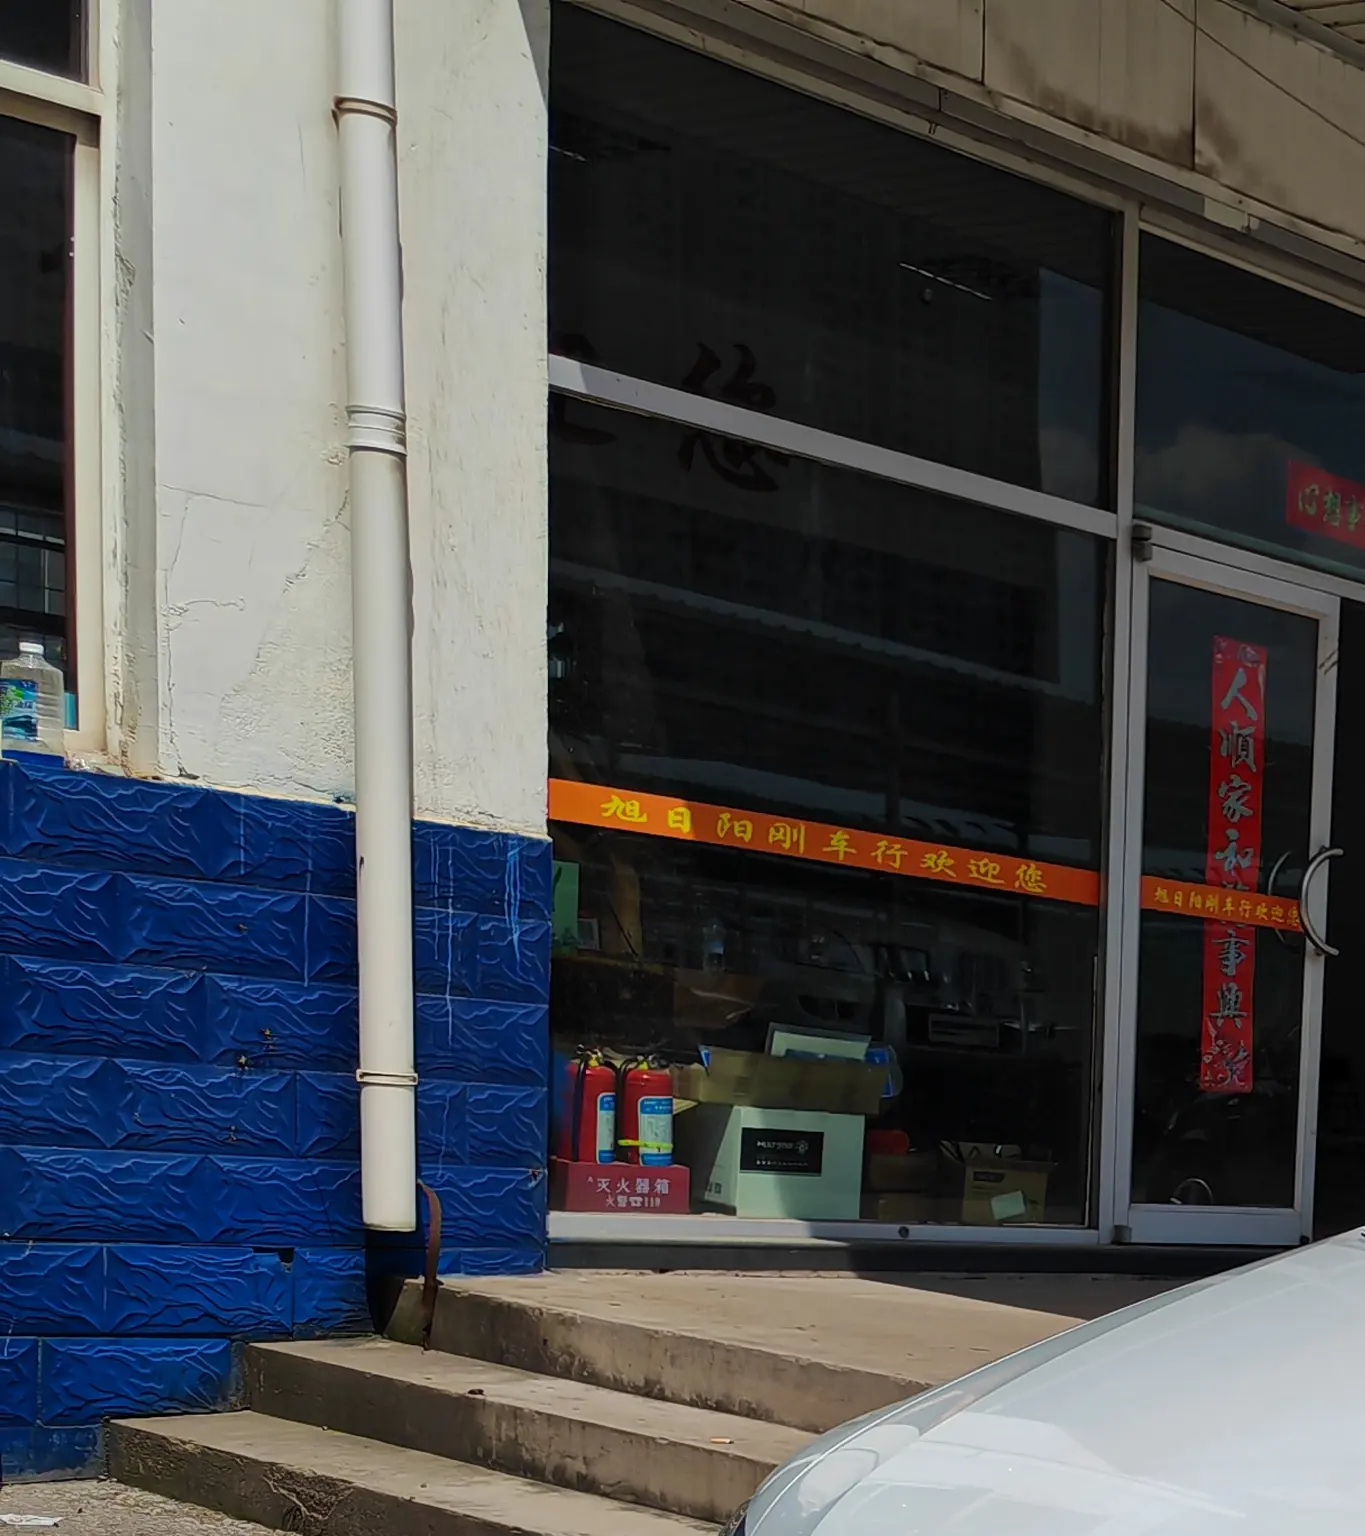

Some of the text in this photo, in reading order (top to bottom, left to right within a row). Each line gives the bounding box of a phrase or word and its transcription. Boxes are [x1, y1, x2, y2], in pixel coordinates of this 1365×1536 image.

[600, 795, 1048, 893] 旭日阳刚车行欢迎您
[1209, 667, 1258, 1029] 人順家和事興
[1154, 886, 1300, 926] 旭日阳刚车行欢迎您
[596, 1177, 671, 1194] 灭火器箱
